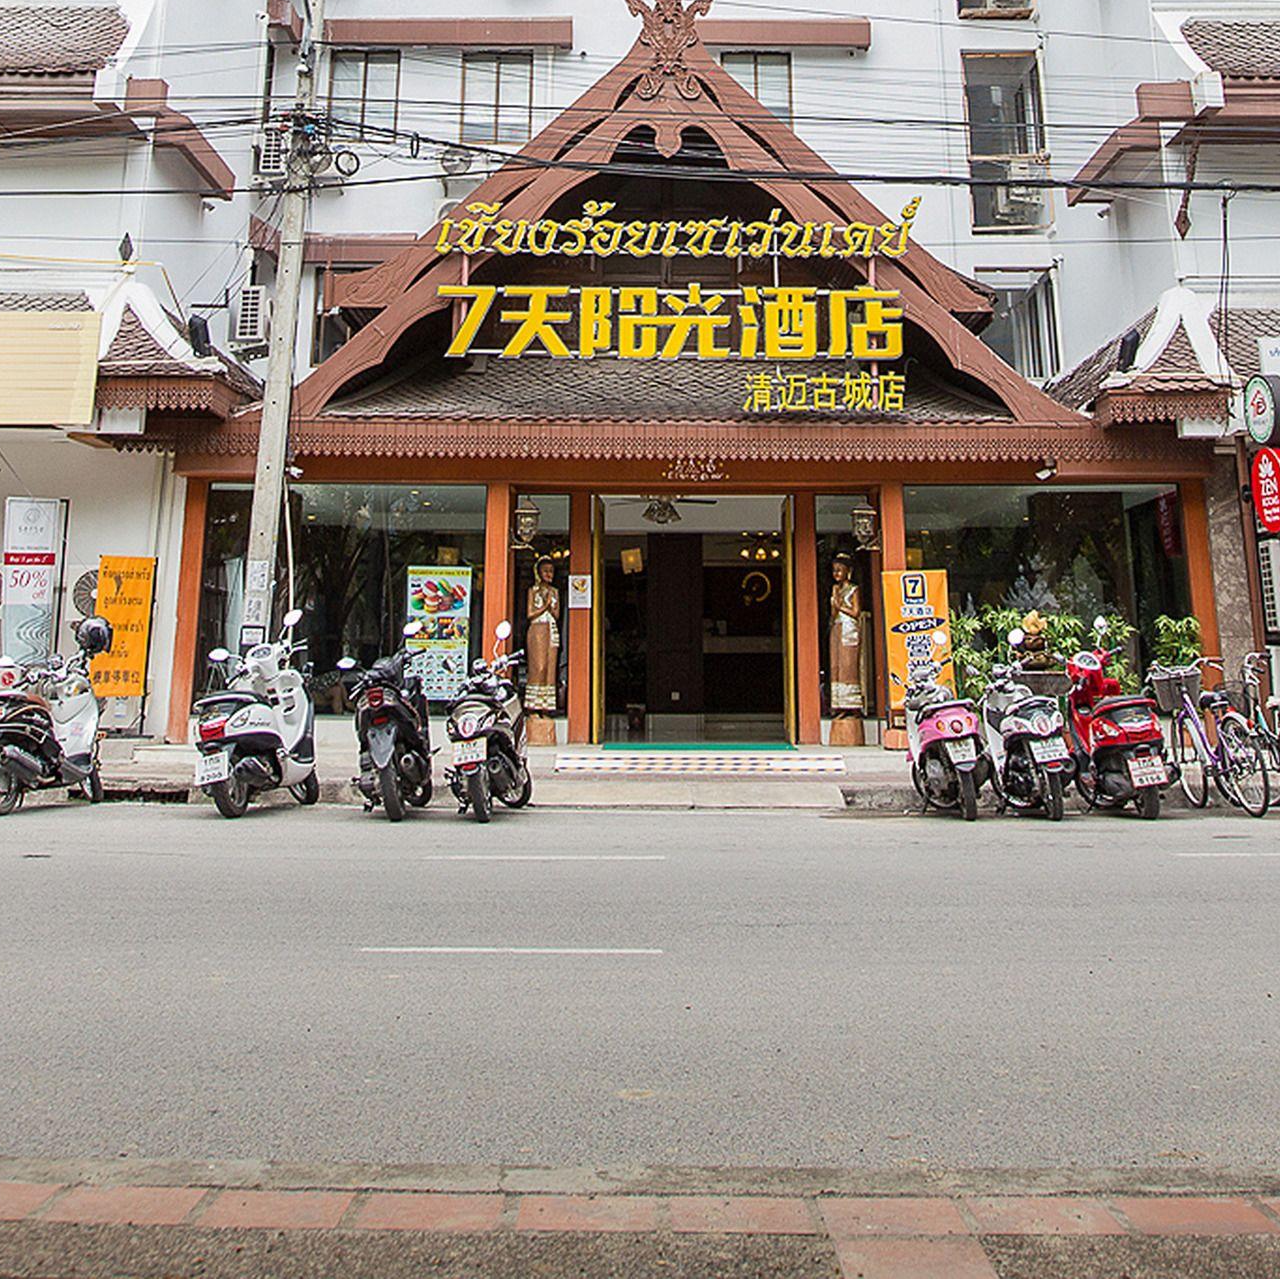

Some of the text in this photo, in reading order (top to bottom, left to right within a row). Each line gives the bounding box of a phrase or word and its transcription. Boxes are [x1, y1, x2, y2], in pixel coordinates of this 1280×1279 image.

[1260, 478, 1278, 496] ZEN
[9, 569, 48, 590] 50%
[898, 618, 937, 632] OPEN
